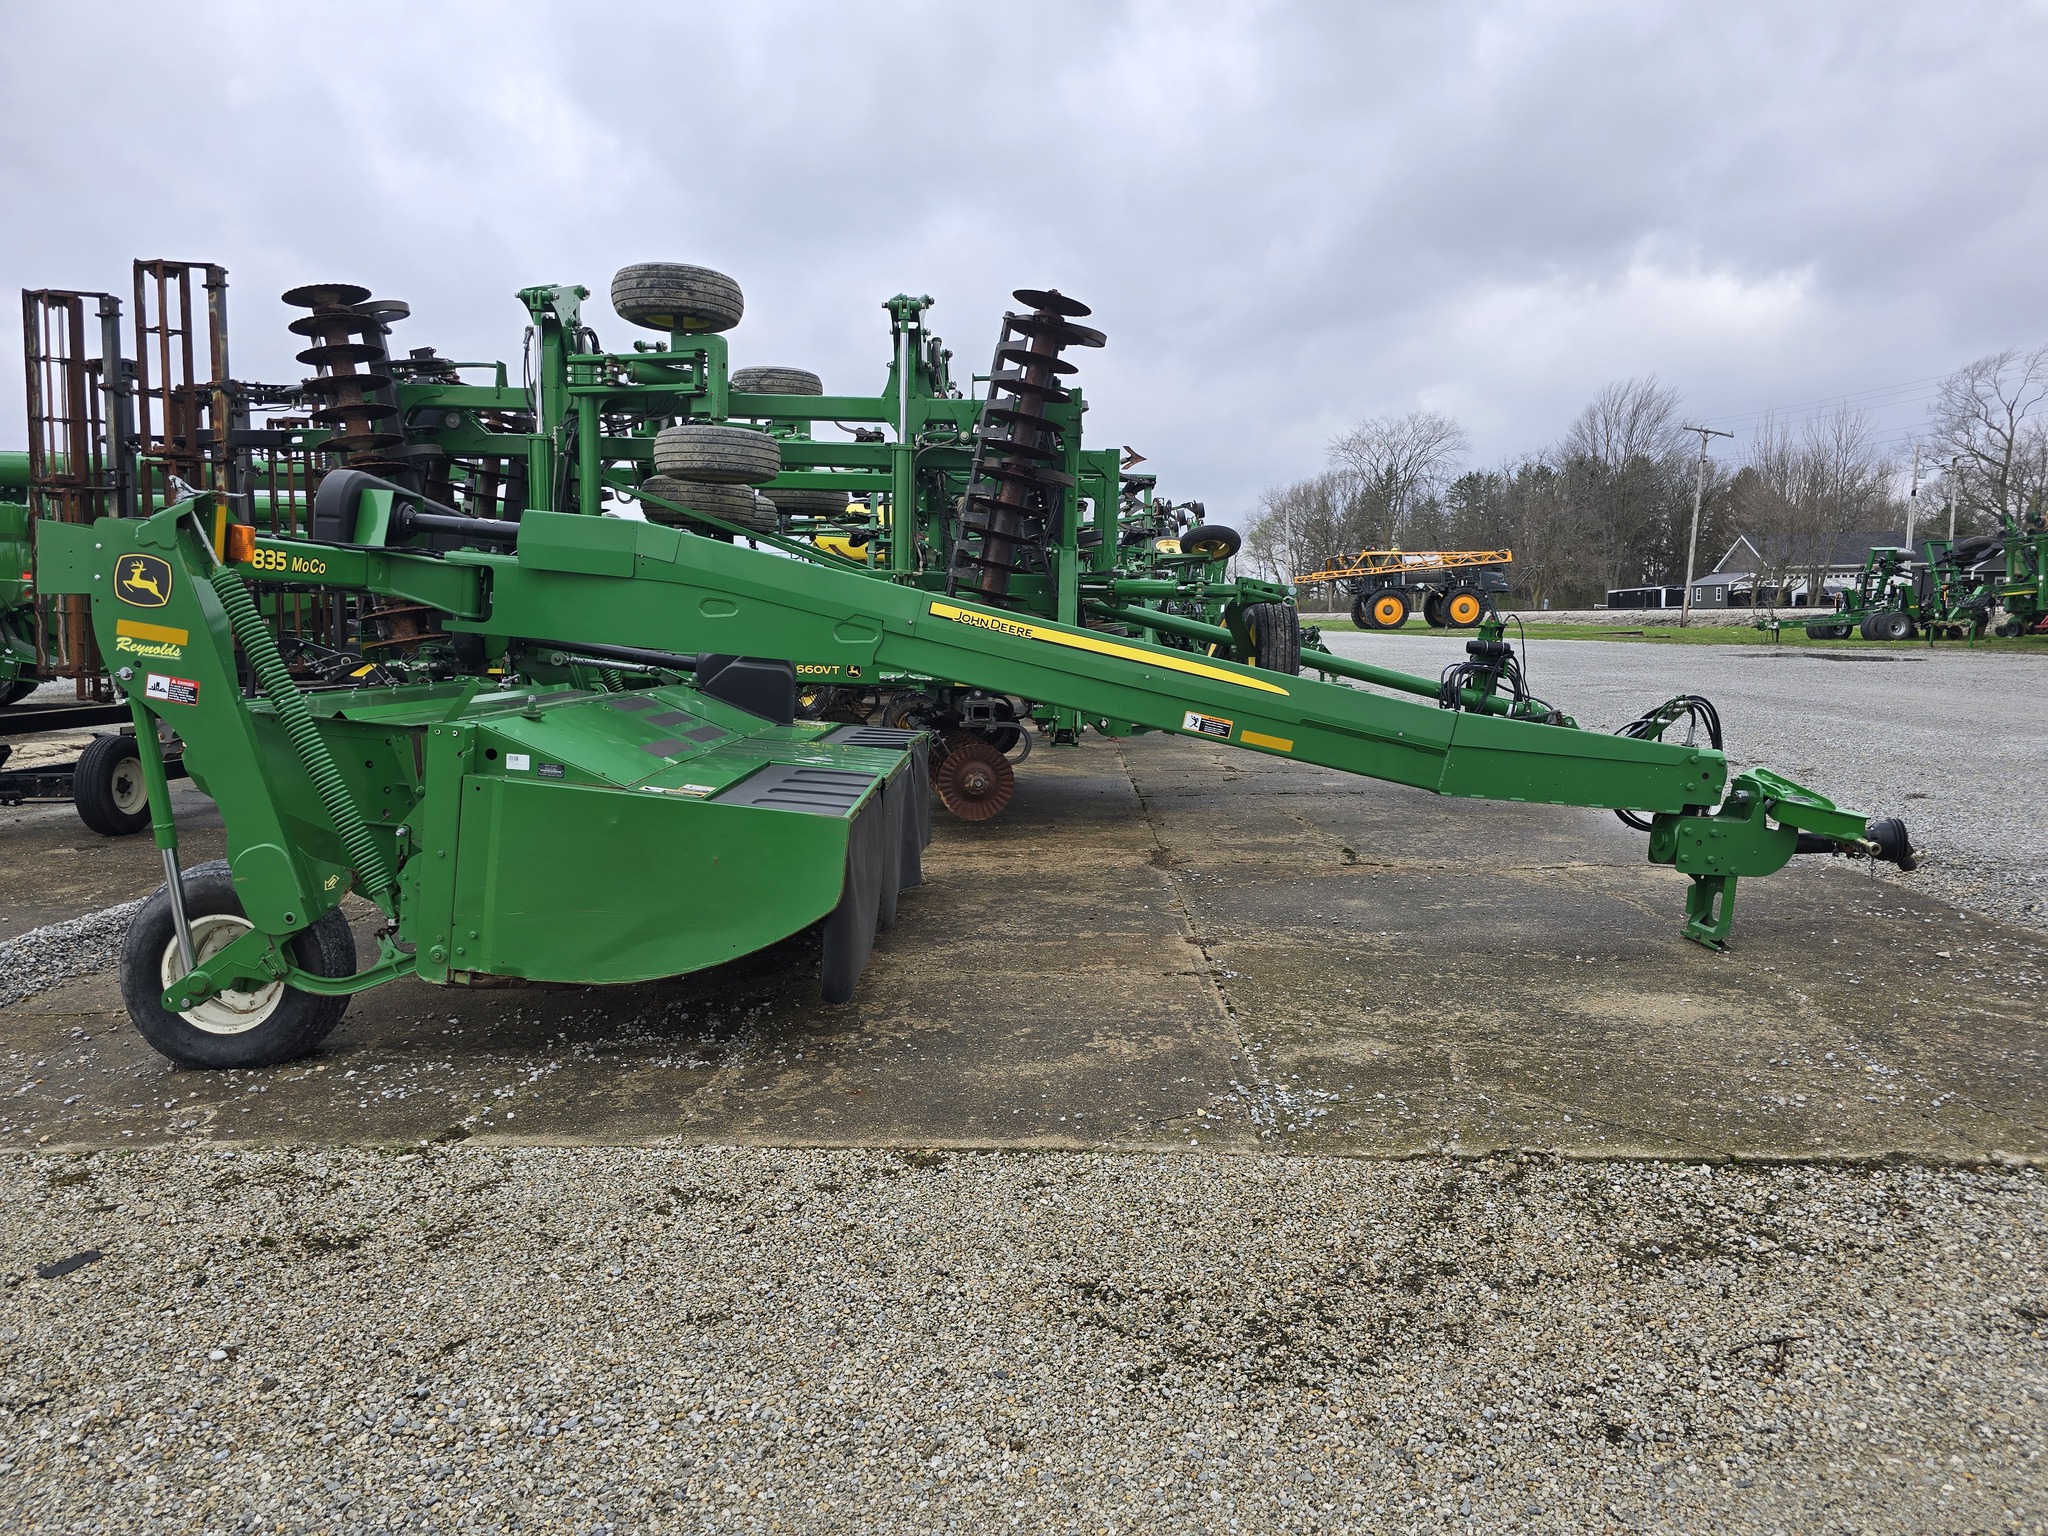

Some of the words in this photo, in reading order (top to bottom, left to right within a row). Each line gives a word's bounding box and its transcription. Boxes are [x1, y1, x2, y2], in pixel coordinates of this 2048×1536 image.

[252, 548, 287, 571] 835
[291, 556, 326, 574] MoCo
[953, 611, 989, 628] JOHN
[990, 618, 1034, 638] DEERE
[116, 636, 182, 657] Reynolds
